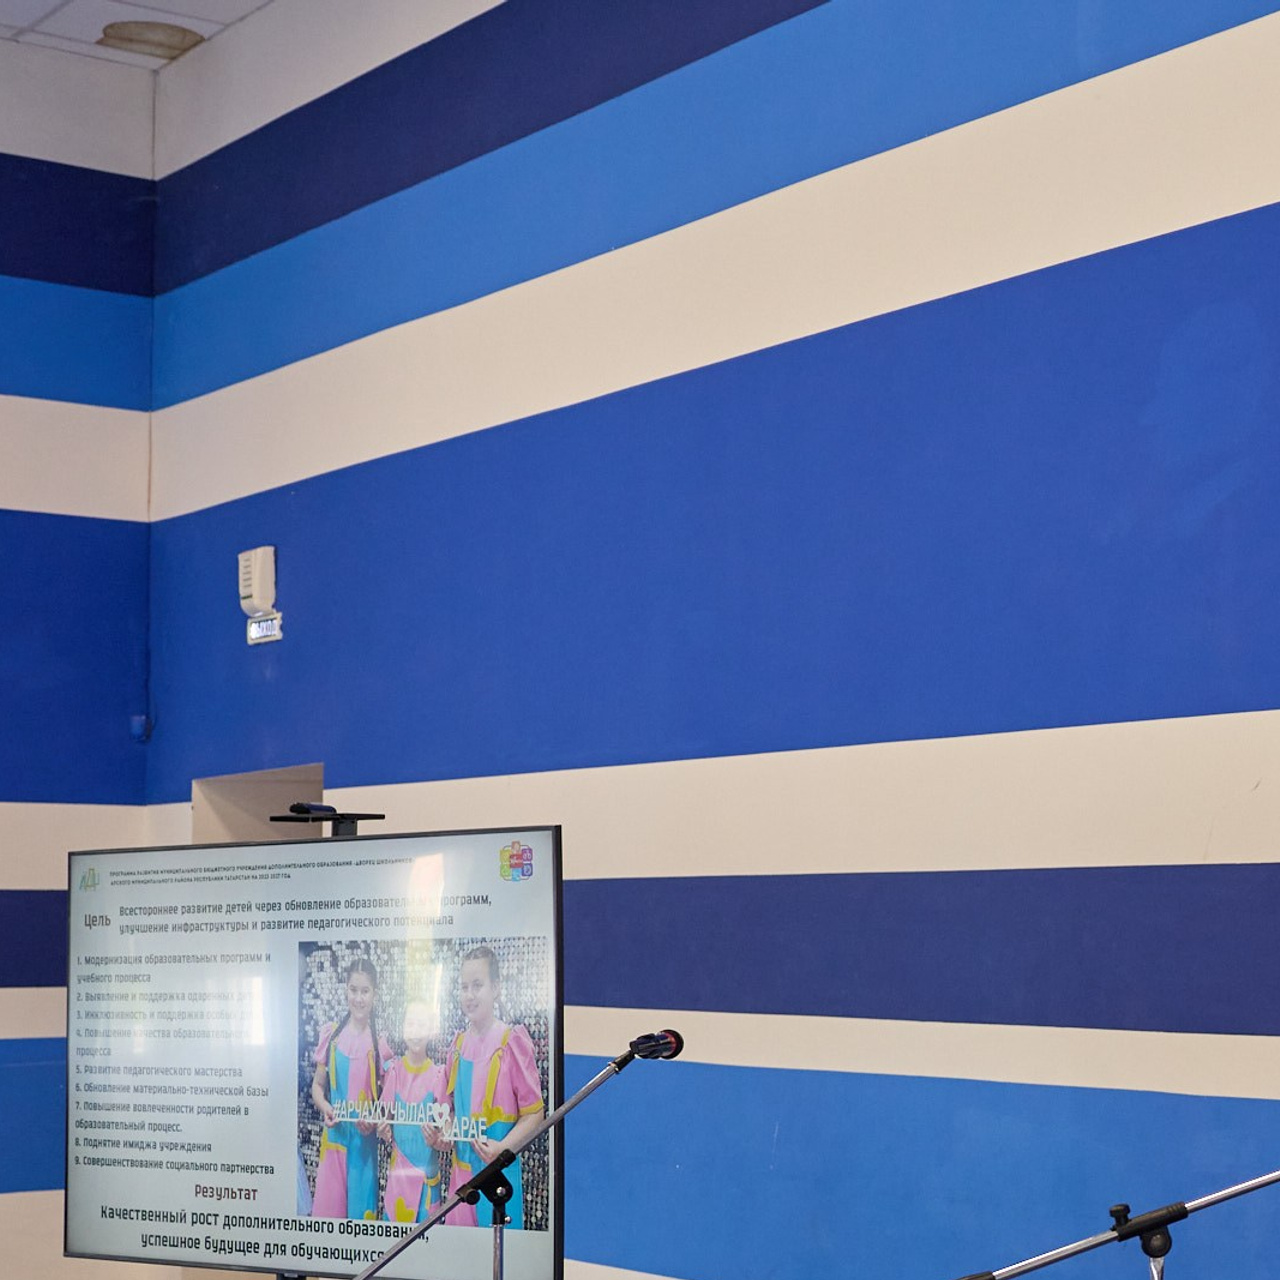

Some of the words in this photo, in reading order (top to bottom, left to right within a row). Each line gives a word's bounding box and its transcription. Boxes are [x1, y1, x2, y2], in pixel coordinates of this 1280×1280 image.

[119, 906, 178, 916] Всестороннее
[181, 905, 222, 916] развитие
[225, 901, 252, 915] детей
[255, 902, 281, 913] через
[285, 899, 341, 911] обновление
[85, 914, 111, 929] Цель
[120, 922, 169, 935] улучшение
[172, 921, 249, 933] инфраструктуры
[252, 921, 257, 929] и
[261, 918, 304, 931] развитие
[307, 915, 390, 930] педагогического
[85, 955, 142, 967] Модернизация
[145, 953, 217, 964] образовательных
[220, 953, 262, 964] программ
[265, 953, 271, 962] и
[77, 973, 112, 984] учебного
[115, 973, 151, 984] процесса
[131, 993, 136, 1001] и
[139, 992, 185, 1003] поддержка
[149, 1011, 155, 1019] и
[157, 1010, 204, 1021] поддержка
[76, 1047, 111, 1056] процесса
[76, 1065, 82, 1074] 5.
[84, 1065, 121, 1075] Развитие
[123, 1066, 191, 1078] педагогического
[194, 1067, 242, 1078] мастерства
[75, 1083, 82, 1092] 6.
[84, 1083, 130, 1093] Обновление
[133, 1084, 244, 1097] материально-технической
[247, 1086, 269, 1097] базы
[75, 1101, 82, 1111] 7.
[83, 1101, 130, 1112] Повышение
[133, 1103, 194, 1114] вовлеченности
[197, 1104, 241, 1116] родителей
[244, 1107, 249, 1116] в
[75, 1119, 146, 1132] образовательный
[148, 1122, 182, 1133] процесс.
[75, 1137, 81, 1147] 8.
[83, 1137, 120, 1149] Поднятие
[123, 1140, 156, 1151] имиджа
[159, 1141, 212, 1153] учреждения
[75, 1156, 81, 1165] 9.
[83, 1156, 163, 1169] Совершенствование
[166, 1160, 218, 1172] социального
[221, 1163, 274, 1175] партнерства
[195, 1184, 258, 1201] Результат
[101, 1205, 187, 1224] Качественный
[191, 1212, 219, 1227] рост
[223, 1215, 334, 1234] дополнительного
[141, 1232, 200, 1250] успешное
[205, 1236, 260, 1255] будущее
[264, 1241, 286, 1257] для
